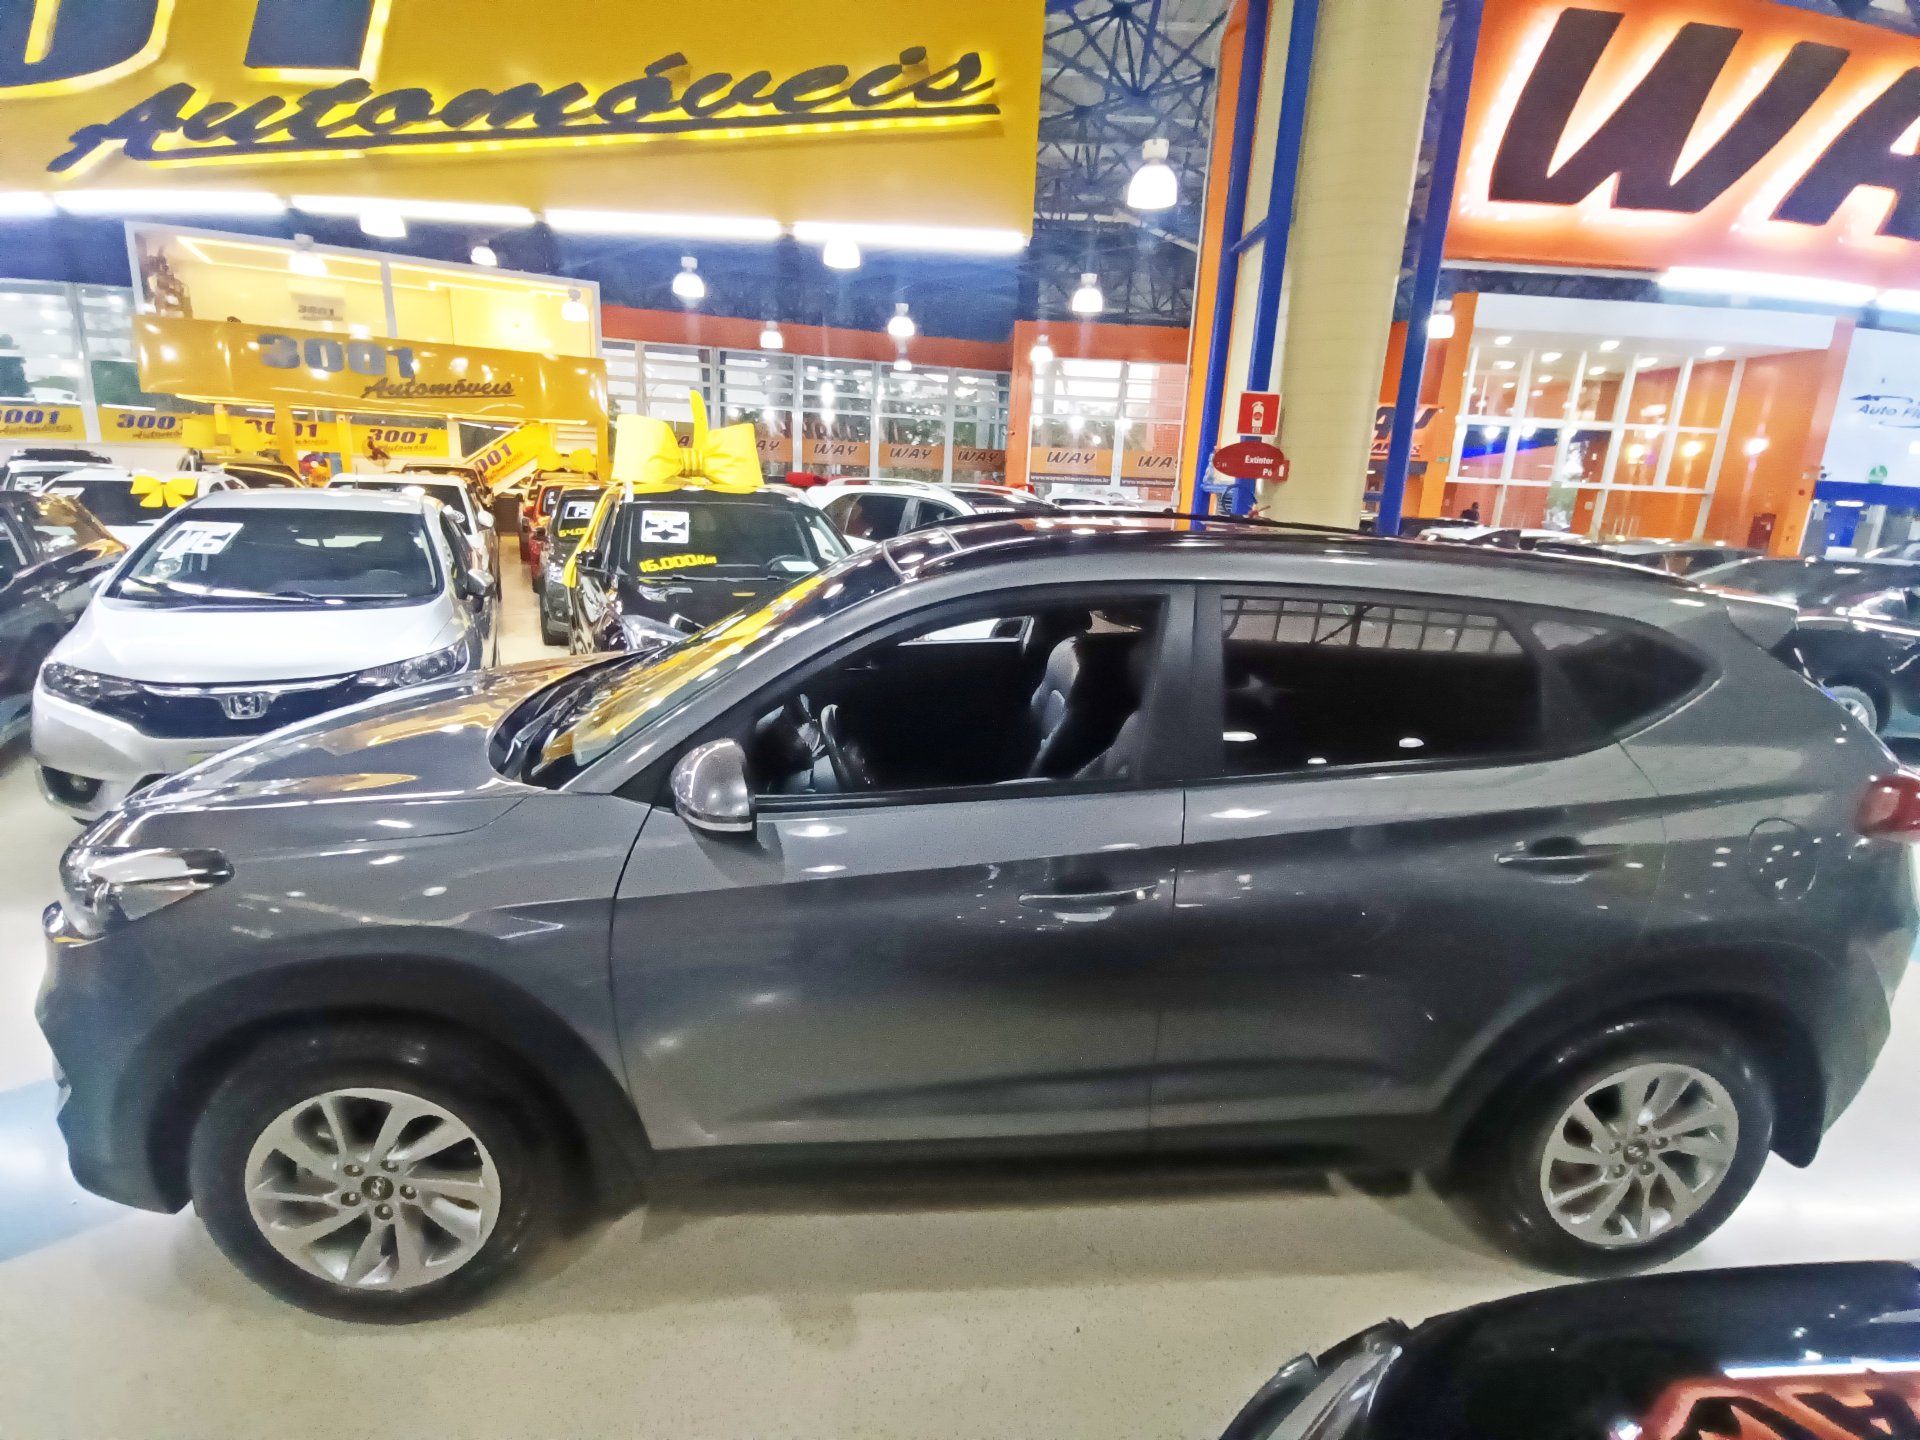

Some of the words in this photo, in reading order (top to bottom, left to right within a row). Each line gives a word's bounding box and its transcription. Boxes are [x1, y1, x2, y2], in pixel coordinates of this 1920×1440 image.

[47, 47, 999, 172] Automóveis
[258, 333, 415, 379] 3001
[360, 377, 515, 398] Automóveis
[0, 409, 59, 424] 001
[117, 413, 183, 430] 300
[369, 428, 429, 444] 3001
[757, 440, 780, 450] AY
[814, 444, 857, 455] WAY
[475, 443, 512, 473] 001
[890, 447, 932, 460] WAY
[958, 451, 999, 462] WAY
[1047, 451, 1096, 464] WAY
[1245, 455, 1273, 465] Extintor
[1262, 468, 1273, 477] Pó
